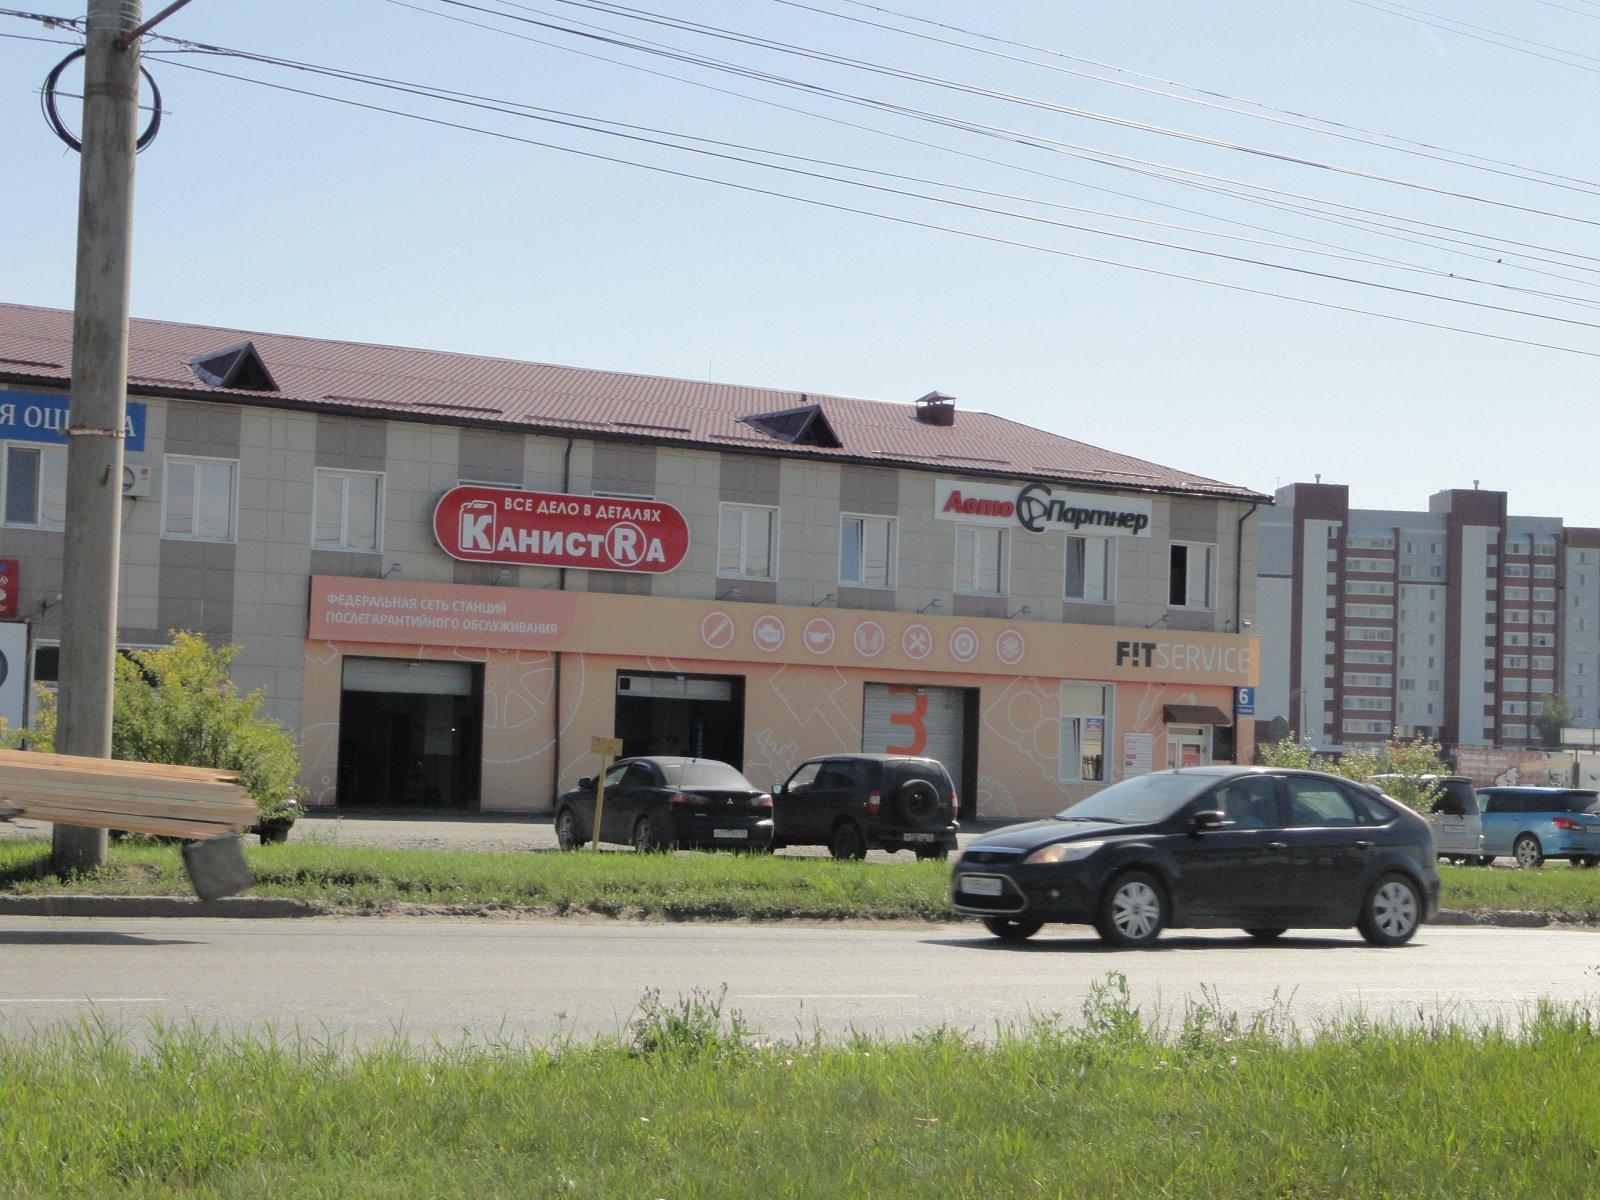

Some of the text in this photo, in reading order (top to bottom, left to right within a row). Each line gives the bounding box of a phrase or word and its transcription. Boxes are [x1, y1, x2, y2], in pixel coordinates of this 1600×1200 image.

[24, 406, 136, 437] ОЦА
[505, 498, 661, 522] ВСЕ ДЕЛО В ДЕТАЛЯХ
[943, 490, 1149, 535] Авто Партнер
[327, 593, 507, 614] ФЕДЕРАЛЬНАЯ СЕТЬ СТАНЦИЙ
[326, 611, 558, 634] ПОСЛЕГАРАНТИЙНОГО ОБСЛУЖИВАНИЯ
[1239, 688, 1249, 705] 6
[886, 685, 929, 757] 3
